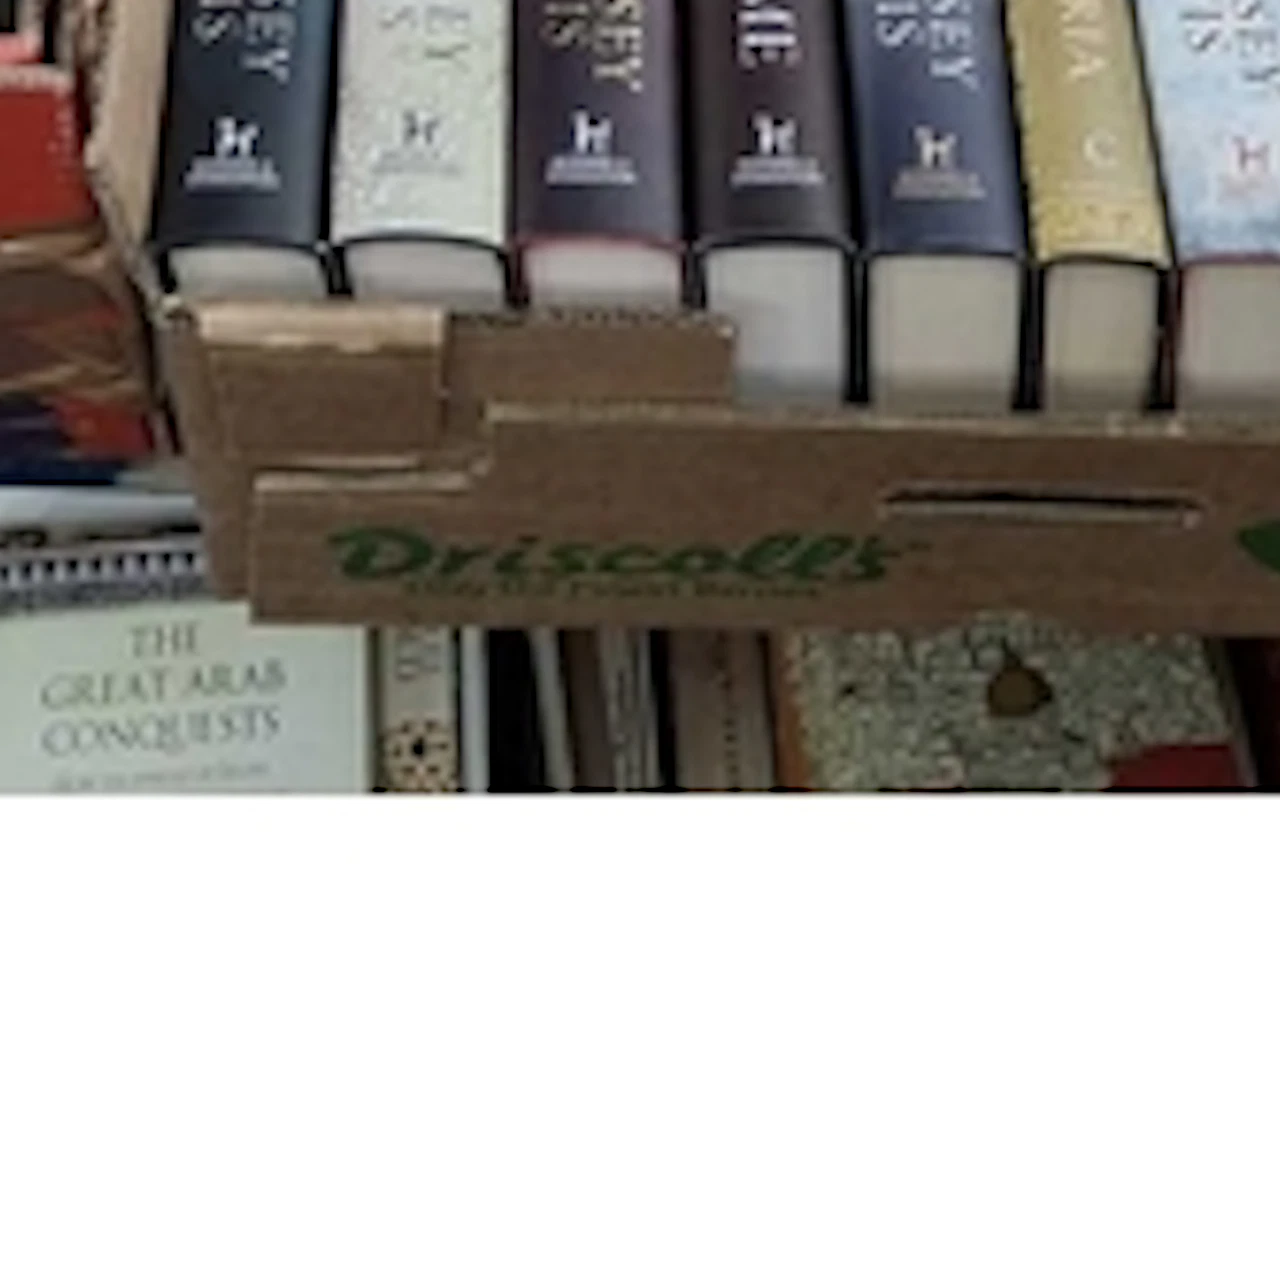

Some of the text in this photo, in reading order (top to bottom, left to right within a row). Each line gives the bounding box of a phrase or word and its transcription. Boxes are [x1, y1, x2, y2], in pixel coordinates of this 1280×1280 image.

[128, 621, 202, 658] THE
[39, 658, 288, 711] GREAT ARAB
[39, 704, 282, 758] CONQUESTS
